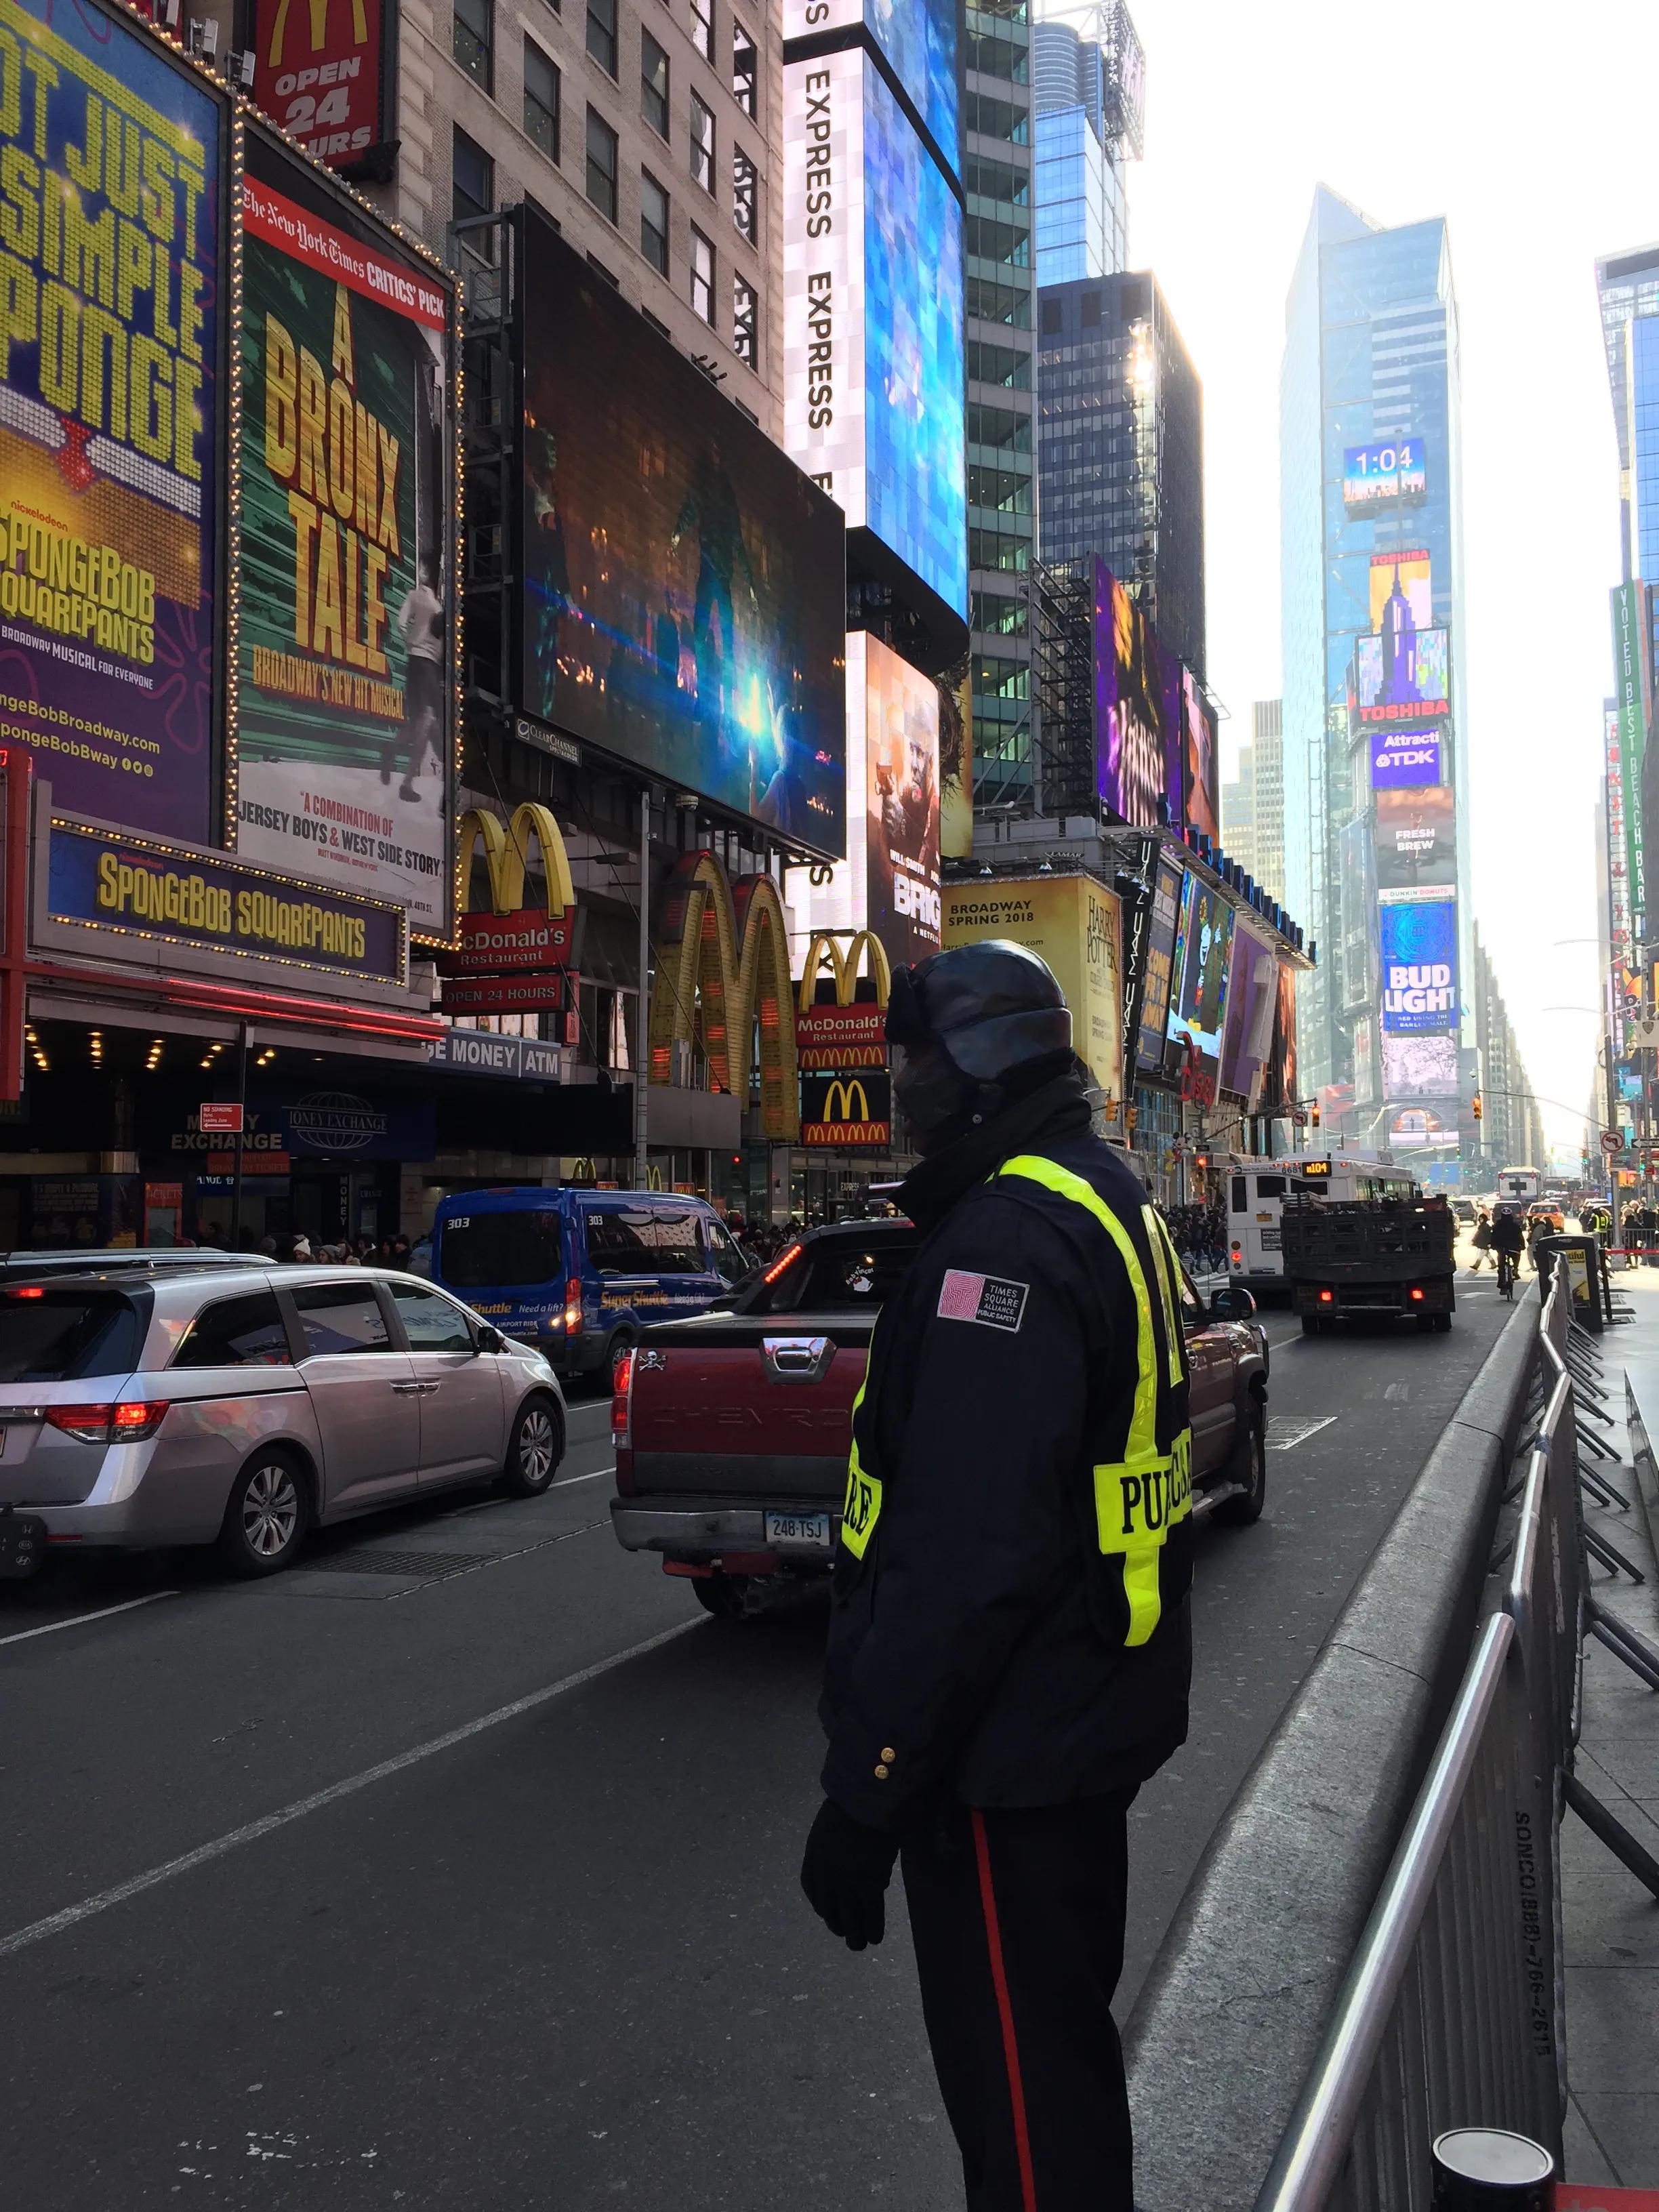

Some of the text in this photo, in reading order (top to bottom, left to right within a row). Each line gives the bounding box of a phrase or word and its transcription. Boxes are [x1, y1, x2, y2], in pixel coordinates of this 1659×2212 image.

[274, 56, 361, 96] OPEN
[285, 86, 350, 136] 24
[806, 70, 832, 239] EXPRESS
[66, 91, 205, 261] JUST
[0, 144, 203, 363] SIMPLE
[243, 186, 445, 319] The New York Times CRITICS' PICK
[332, 283, 354, 386] A
[808, 271, 832, 430] EXPRESS
[265, 310, 400, 557] BRONX
[1356, 445, 1413, 475] 1:04
[11, 499, 68, 532] nickelodeon
[1371, 549, 1429, 565] TOSHIBA
[287, 490, 386, 675] TALE
[1, 625, 153, 691] BROADWAY MUSICAL FOR EVERYONE
[253, 643, 405, 720] BROADWAY'S NEW HIT MUSICAL
[1359, 699, 1449, 722] TOSHIBA
[1626, 682, 1635, 752] BEST
[1389, 749, 1435, 767] TDK
[1630, 757, 1643, 844] BEACH
[313, 795, 380, 834] COMBINATION
[382, 817, 393, 838] OF
[238, 800, 290, 834] JERSEY
[293, 815, 328, 845] BOYS
[329, 826, 339, 848] &
[342, 829, 375, 858] WEST
[377, 840, 403, 866] SIDE
[1395, 828, 1435, 840] FRESH
[1397, 840, 1434, 851] BREW
[890, 848, 905, 866] WILL
[905, 857, 925, 876] SMITH
[1635, 850, 1645, 903] BAR
[99, 852, 365, 959] SPONGEBOB SQUAREPANTS
[949, 912, 1034, 926] SPRING 2018
[951, 900, 1031, 914] BROADWAY
[1088, 895, 1115, 943] HARRY
[913, 926, 918, 935] A
[461, 950, 543, 966] Restaurant
[1087, 927, 1118, 974] POTTER
[1389, 964, 1450, 989] BUD
[446, 987, 555, 1003] OPEN 24 HOURS
[1385, 986, 1456, 1013] LIGHT
[798, 1015, 886, 1032] McDonald's
[813, 1030, 874, 1042] Restaurant
[453, 1038, 515, 1068] MONEY
[525, 1050, 558, 1074] ATM
[327, 1114, 387, 1131] EXCHANGE
[171, 1133, 282, 1150] EXCHANGE
[340, 1176, 348, 1226] MONEY
[840, 1183, 859, 1191] EXPRESS
[447, 1218, 470, 1229] 303
[588, 1215, 603, 1225] 303
[984, 1293, 1019, 1308] SQUARE
[990, 1285, 1017, 1298] TIMES
[519, 1304, 539, 1313] Need
[548, 1303, 564, 1312] lift?
[977, 1309, 1017, 1324] PUBLIC SAFETY
[983, 1303, 1015, 1315] ALLIANCE
